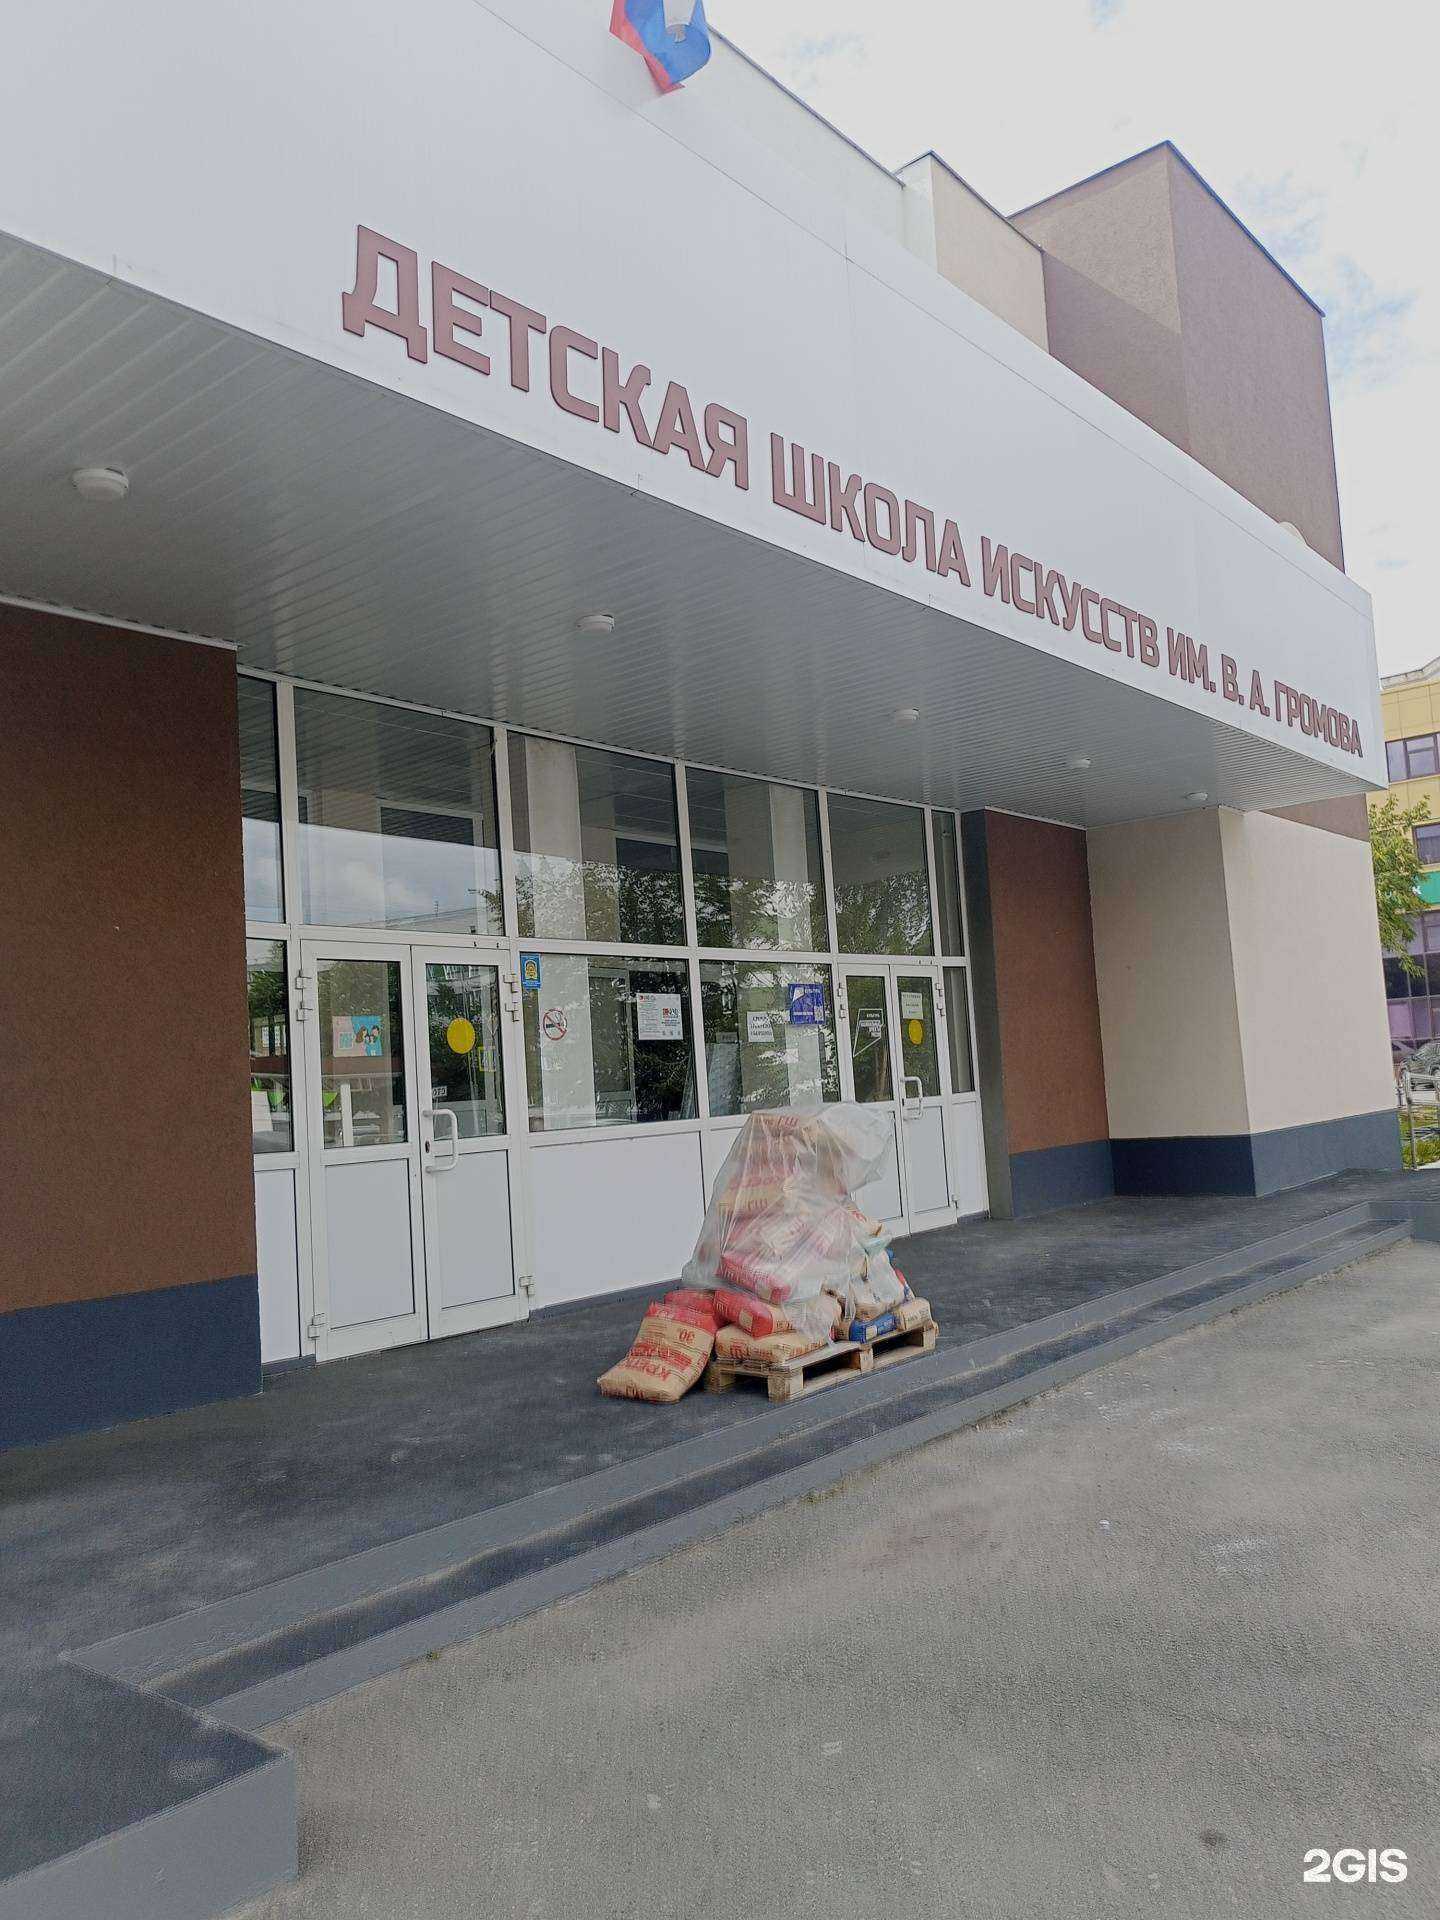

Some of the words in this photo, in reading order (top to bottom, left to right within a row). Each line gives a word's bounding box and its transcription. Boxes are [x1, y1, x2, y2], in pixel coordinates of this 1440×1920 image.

[342, 224, 749, 490] ДЕТСКАЯ
[770, 432, 971, 587] ШКОЛА
[981, 535, 1160, 668] ИСКУССТВ
[1166, 627, 1216, 693] ИМ.
[1221, 652, 1244, 706] В.
[1249, 669, 1271, 717] А.
[1274, 680, 1363, 758] ГРОМОВА
